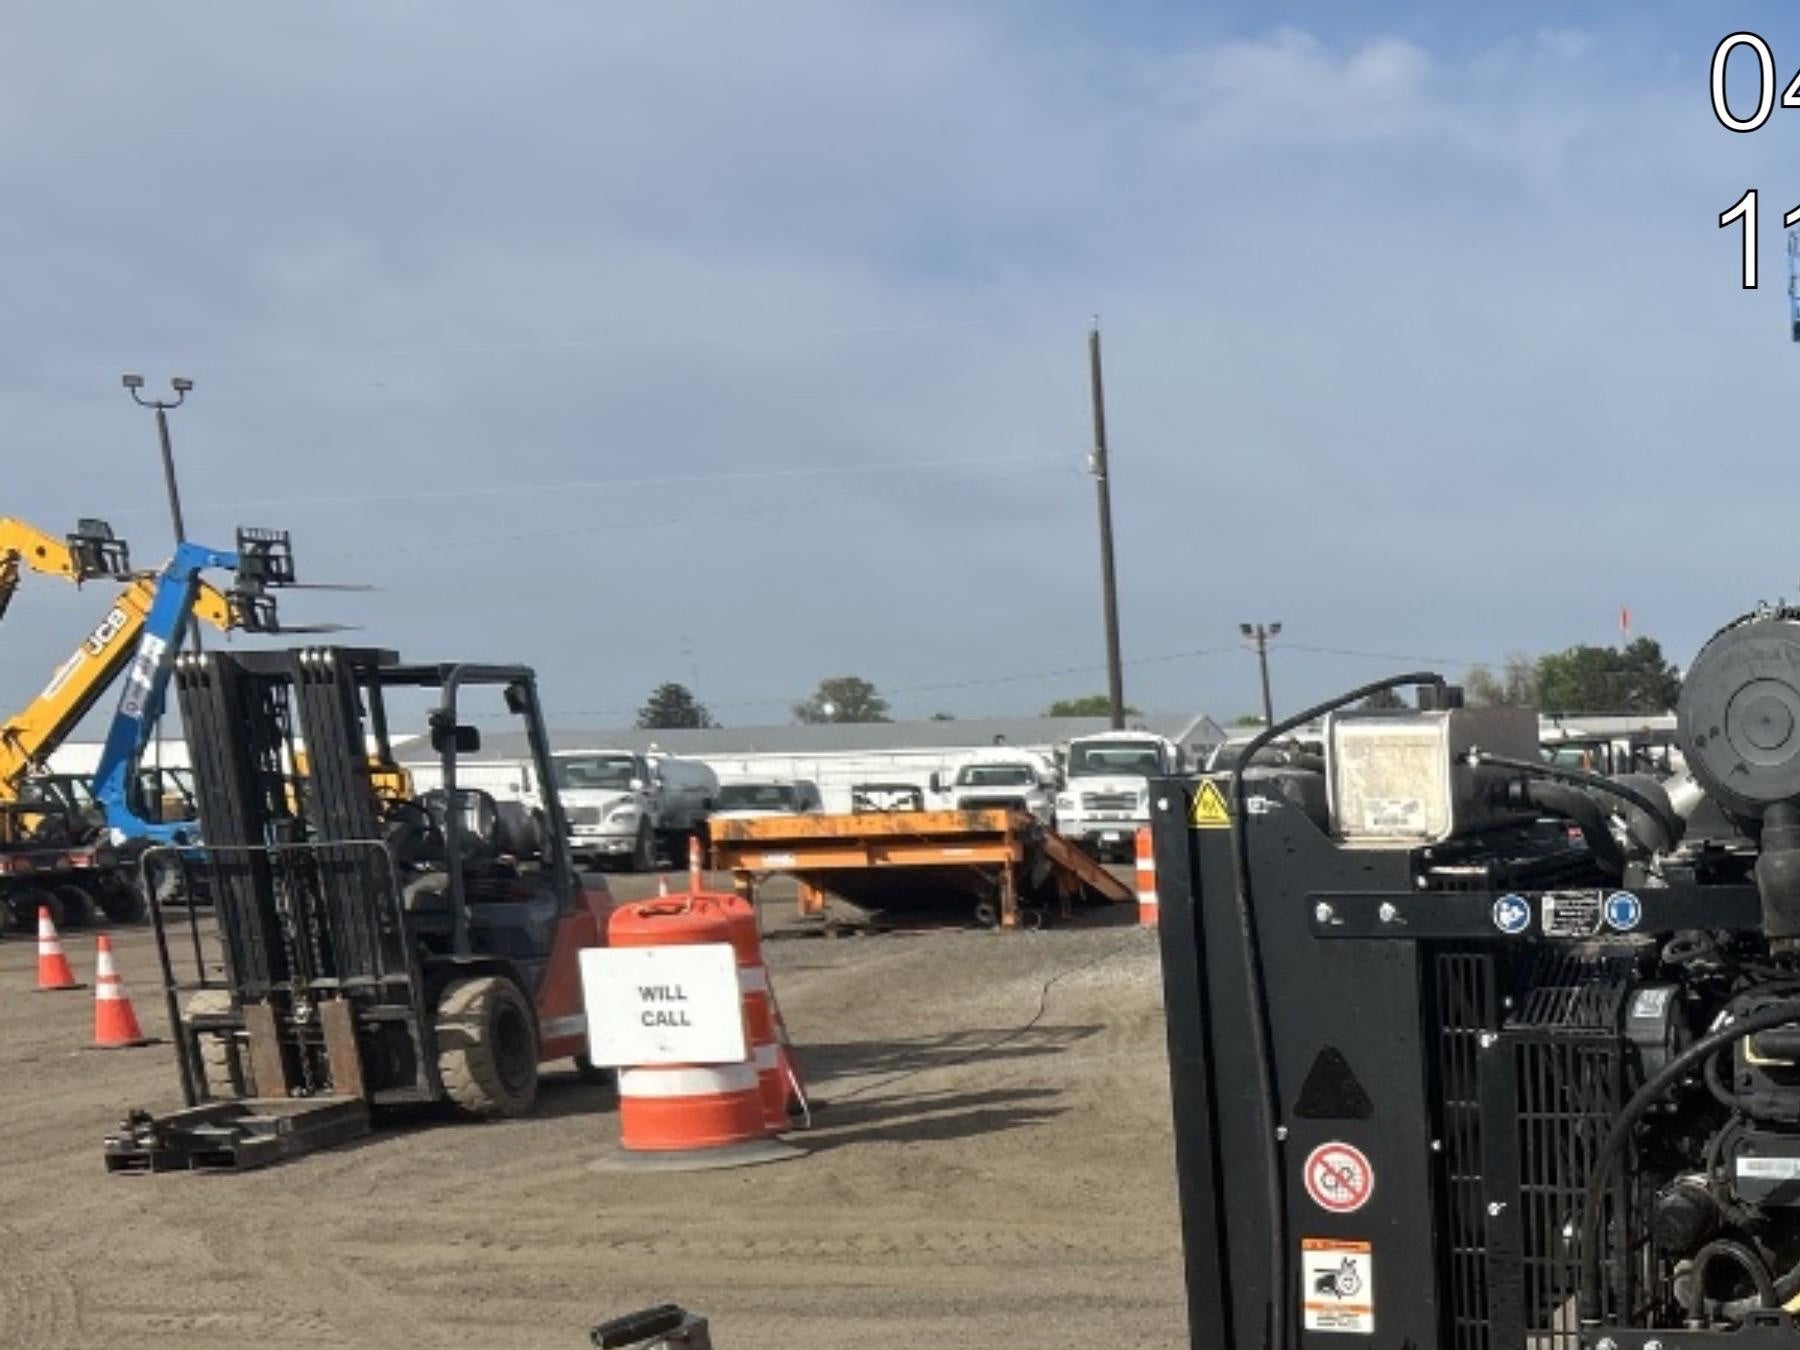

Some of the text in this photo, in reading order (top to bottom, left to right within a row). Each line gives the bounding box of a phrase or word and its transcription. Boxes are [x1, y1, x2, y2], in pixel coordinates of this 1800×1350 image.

[86, 608, 127, 655] JCB
[638, 984, 689, 1002] WILL
[641, 1009, 693, 1028] CALL
